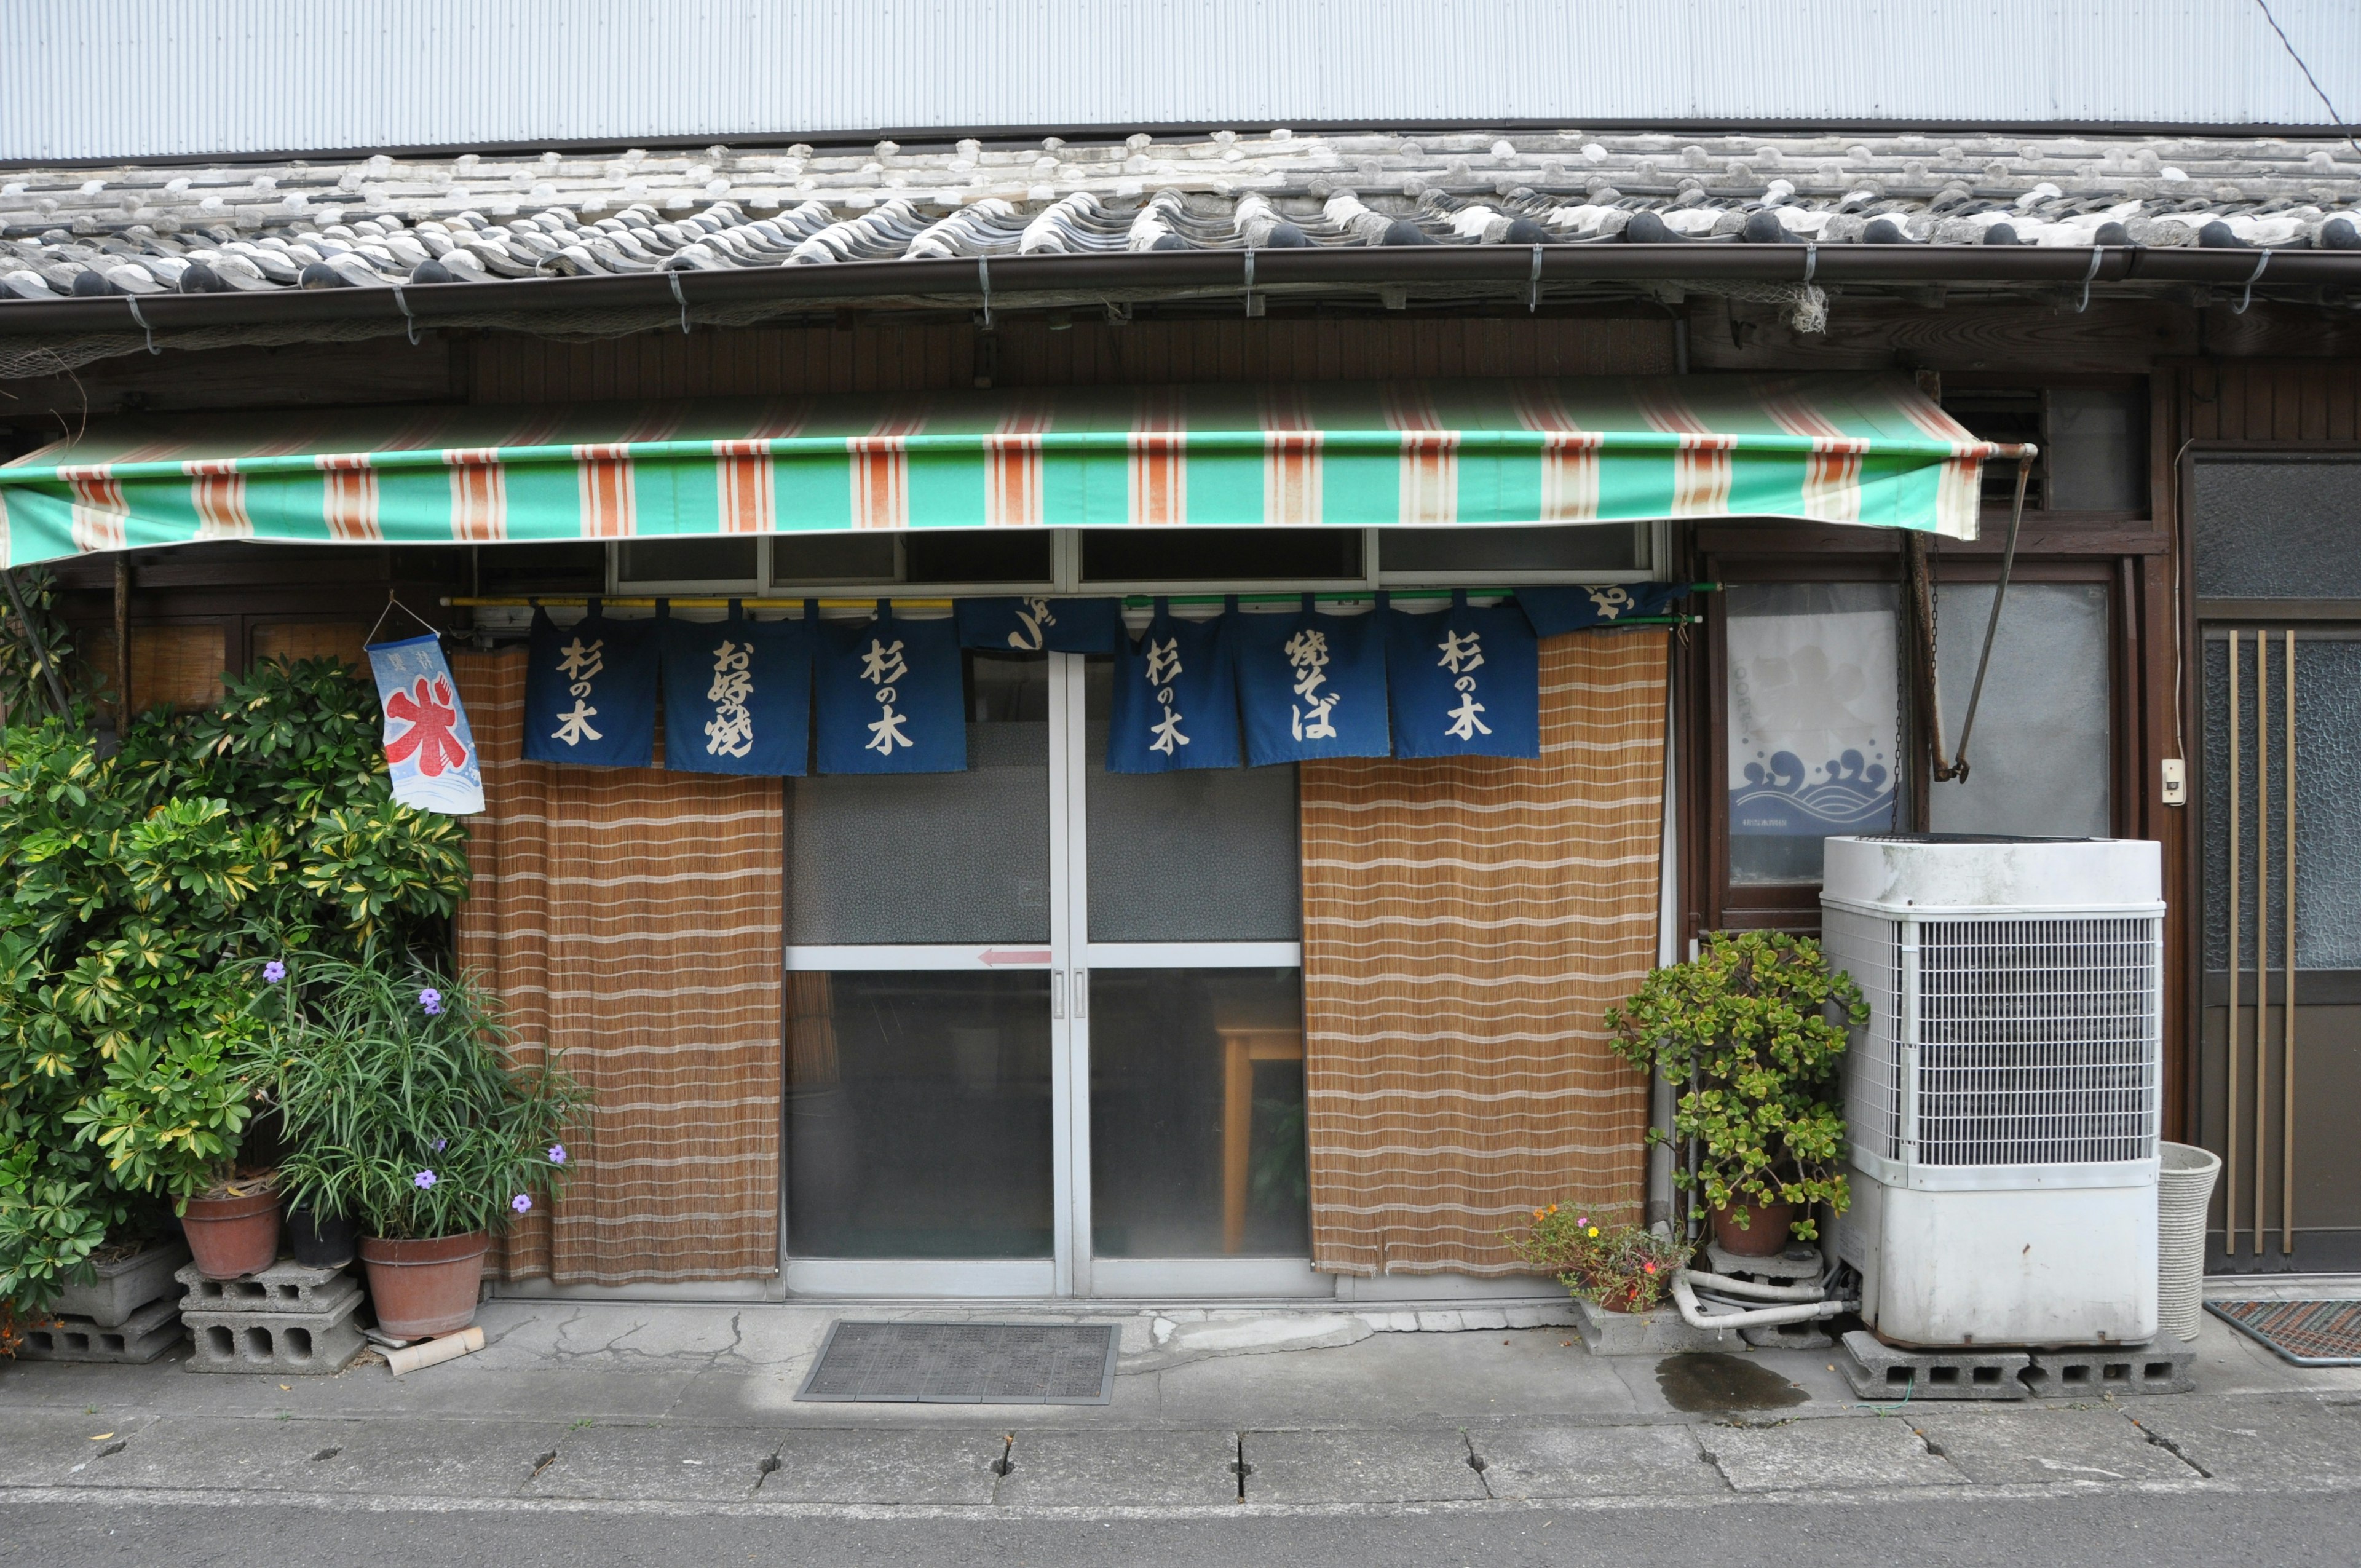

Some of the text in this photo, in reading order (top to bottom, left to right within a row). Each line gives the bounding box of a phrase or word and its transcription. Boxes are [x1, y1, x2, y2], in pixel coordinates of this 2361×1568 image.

[550, 636, 603, 746] 杉の木
[704, 639, 754, 758] お好み焼
[861, 639, 914, 756] 杉の木
[1147, 638, 1190, 756] 杉の木
[1284, 630, 1341, 742] 焼そば
[1437, 630, 1493, 742] 杉の木
